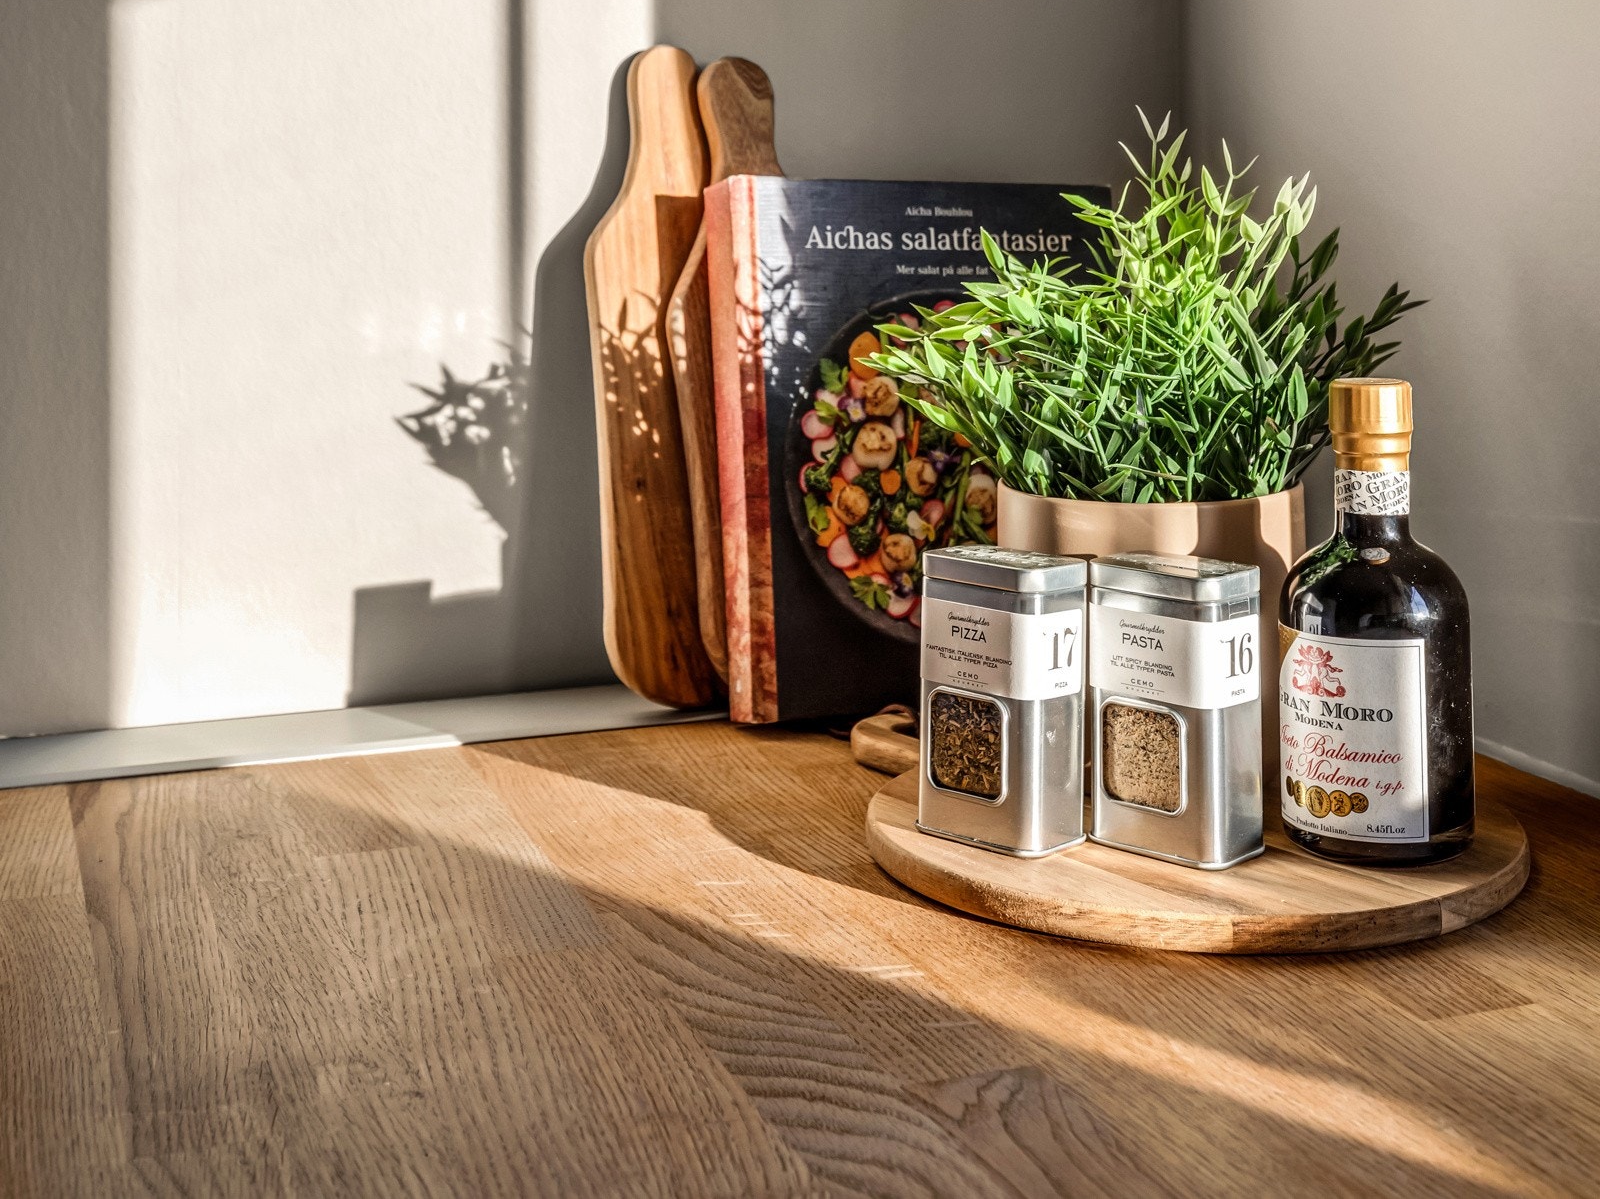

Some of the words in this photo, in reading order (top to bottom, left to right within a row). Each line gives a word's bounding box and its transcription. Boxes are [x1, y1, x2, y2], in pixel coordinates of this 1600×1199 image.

[905, 206, 932, 216] Aicha
[804, 225, 893, 250] Aichas
[896, 265, 914, 275] Mer
[918, 265, 940, 275] salat
[942, 266, 954, 277] på
[956, 266, 974, 275] alle
[976, 266, 989, 275] fat
[1368, 481, 1408, 507] MORO
[952, 625, 987, 643] PIZZA
[1122, 632, 1164, 651] PASTA
[926, 644, 956, 655] FANTASTISK
[957, 650, 983, 660] ITALIENSK
[1043, 627, 1078, 671] 17
[1220, 633, 1253, 678] 16
[949, 654, 961, 662] ALLE
[964, 657, 981, 665] TYPER
[1125, 657, 1142, 665] SPICY
[957, 670, 979, 680] CEMO
[1120, 662, 1134, 670] ALLE
[1136, 665, 1155, 674] TYPER
[1157, 669, 1175, 677] PASTA
[1130, 678, 1154, 688] CEMO
[1320, 701, 1393, 722] MORO
[1295, 712, 1344, 731] MODENA
[1303, 732, 1403, 764] Balsamico
[1285, 755, 1293, 772] di
[1296, 753, 1370, 788] Modena
[1375, 781, 1404, 796] i.g.p.
[1296, 816, 1319, 829] Prodotto
[1321, 824, 1348, 835] Italiano
[1366, 824, 1406, 834] 8.45fl.oz
